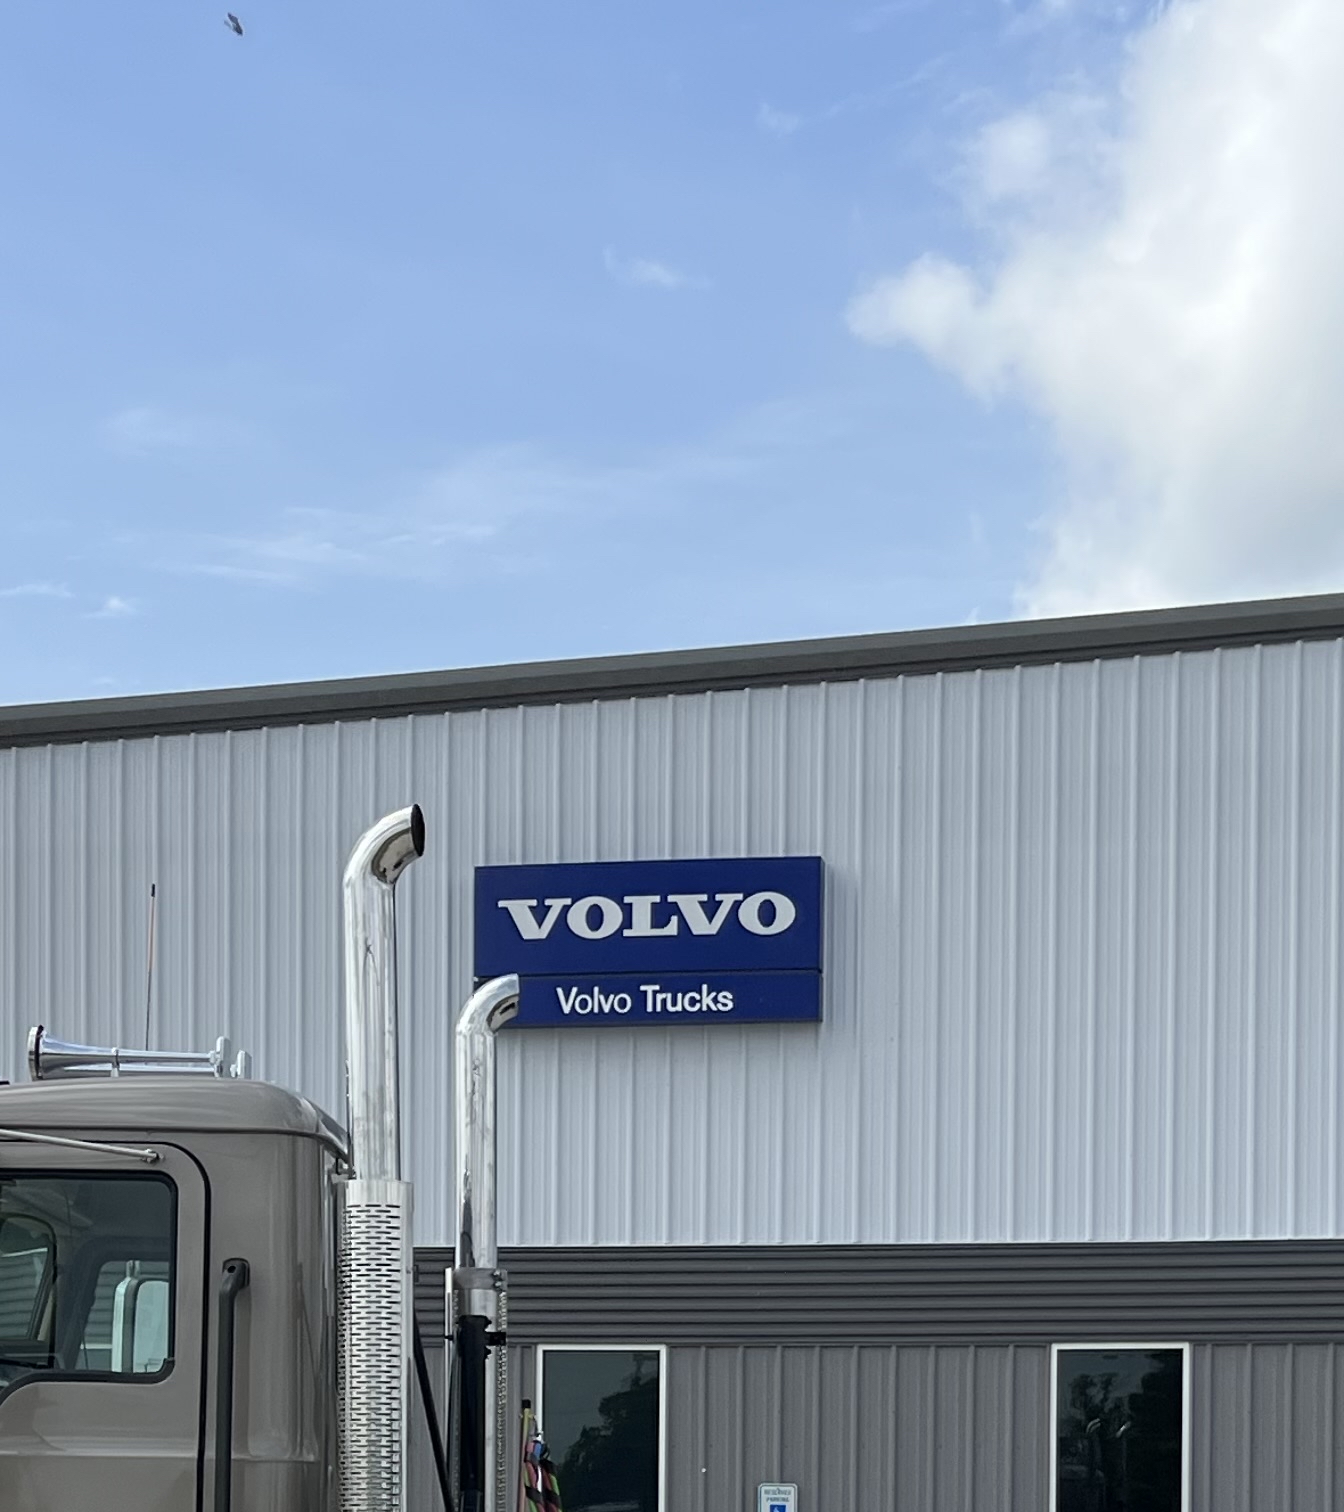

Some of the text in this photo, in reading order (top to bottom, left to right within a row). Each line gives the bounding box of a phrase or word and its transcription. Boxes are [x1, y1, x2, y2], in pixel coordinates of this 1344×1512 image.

[498, 891, 796, 940] VOLVO
[556, 983, 734, 1014] Volvo Trucks
